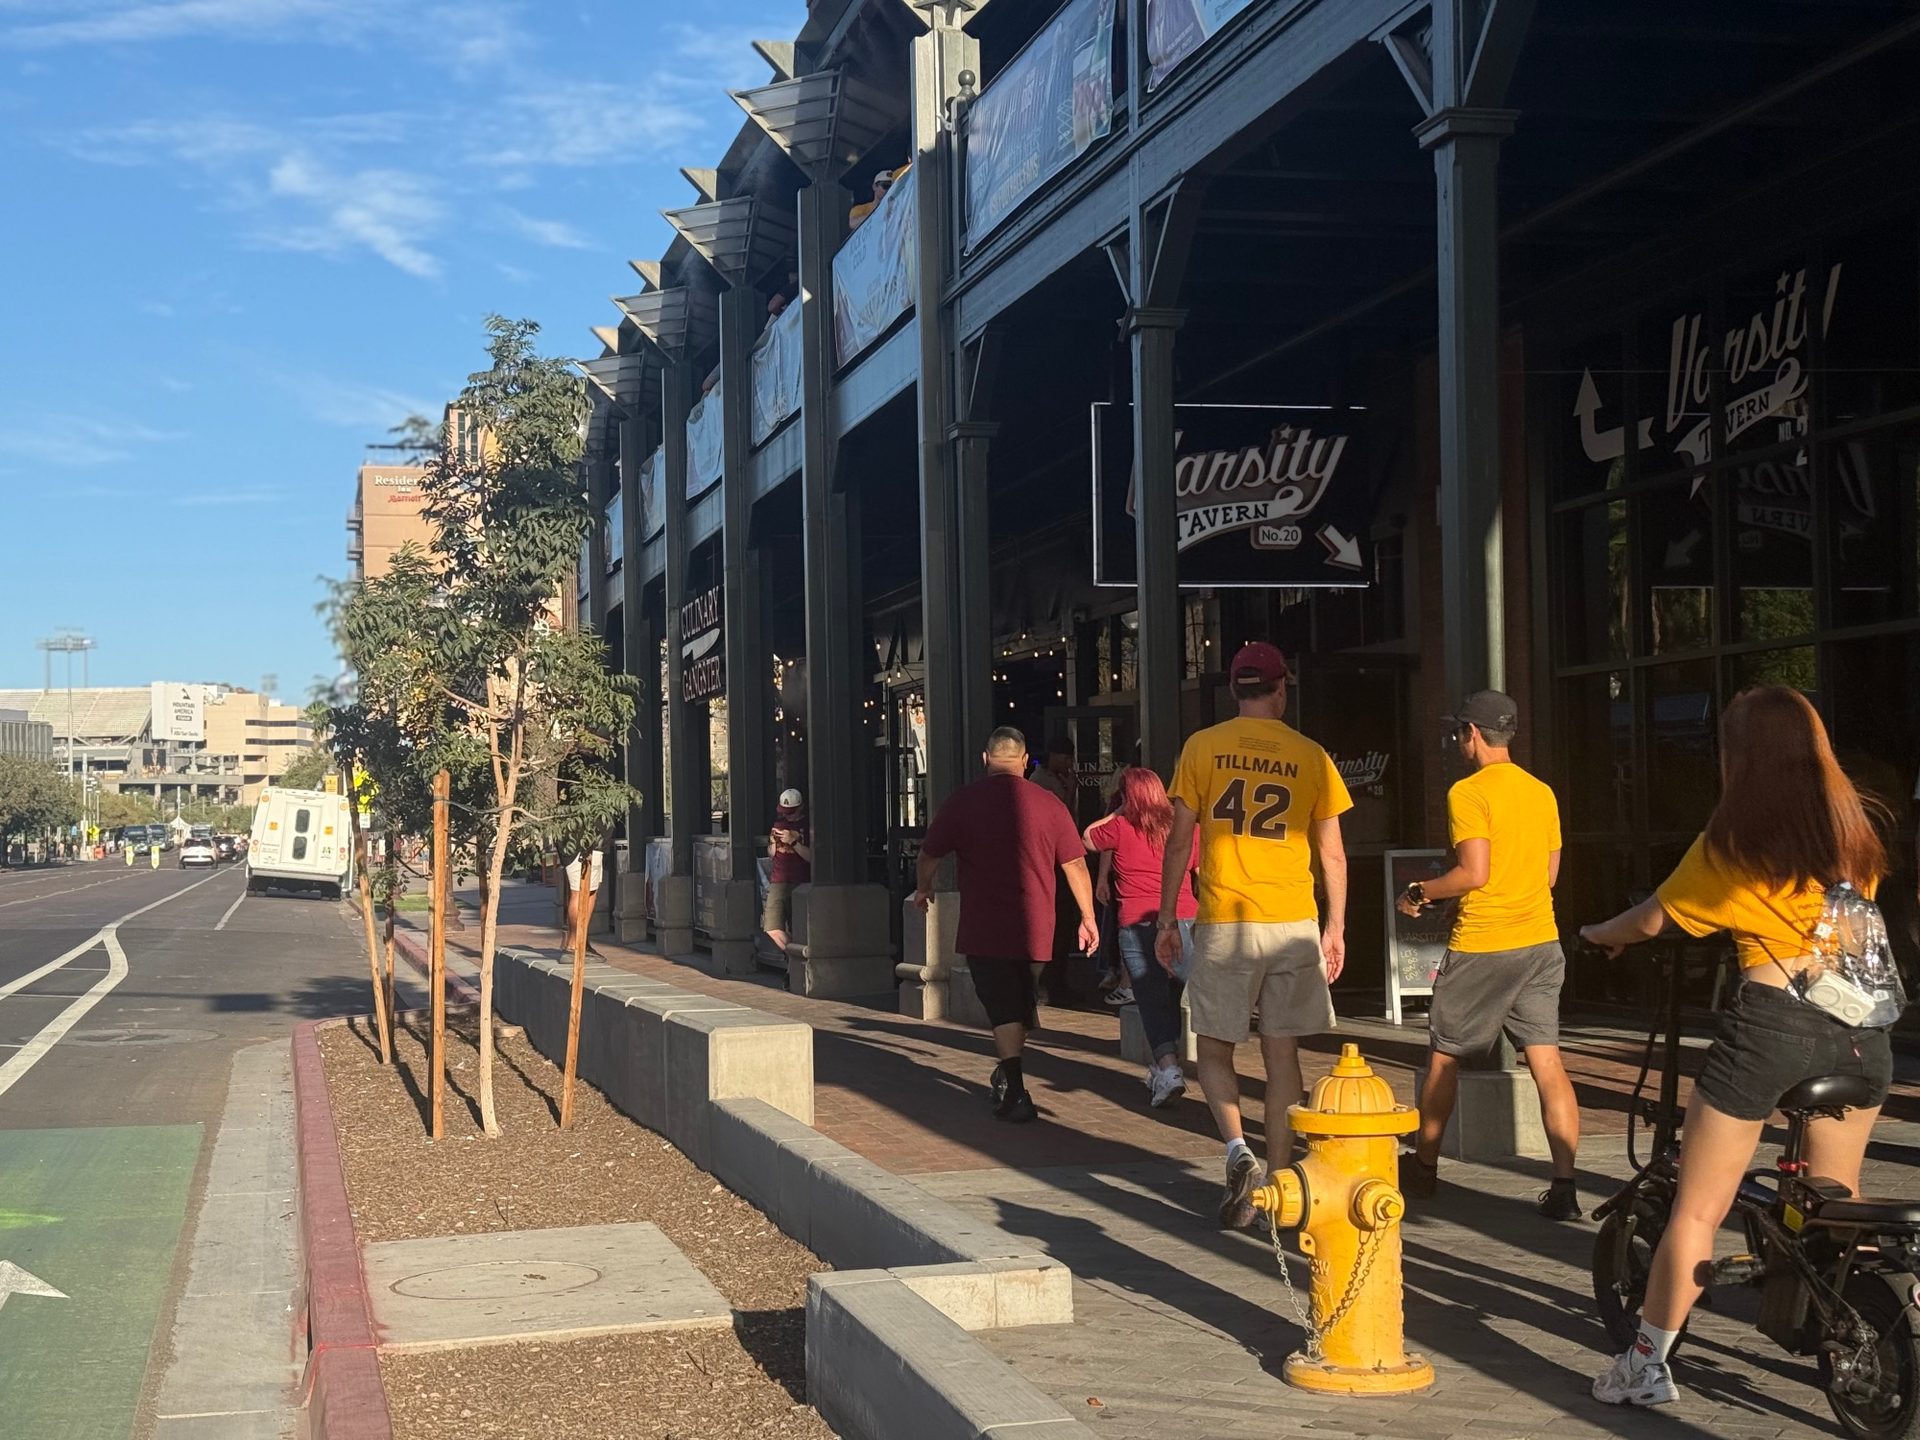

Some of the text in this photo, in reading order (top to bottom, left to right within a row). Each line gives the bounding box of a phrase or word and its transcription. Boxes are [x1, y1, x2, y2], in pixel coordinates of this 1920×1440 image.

[1697, 390, 1771, 458] TVERN
[1174, 424, 1350, 512] arsity
[1261, 528, 1300, 544] No.20
[680, 585, 719, 641] CULINARY
[682, 655, 722, 703] GANGSTER
[1214, 753, 1299, 779] TILLMAN
[1211, 776, 1292, 842] 42
